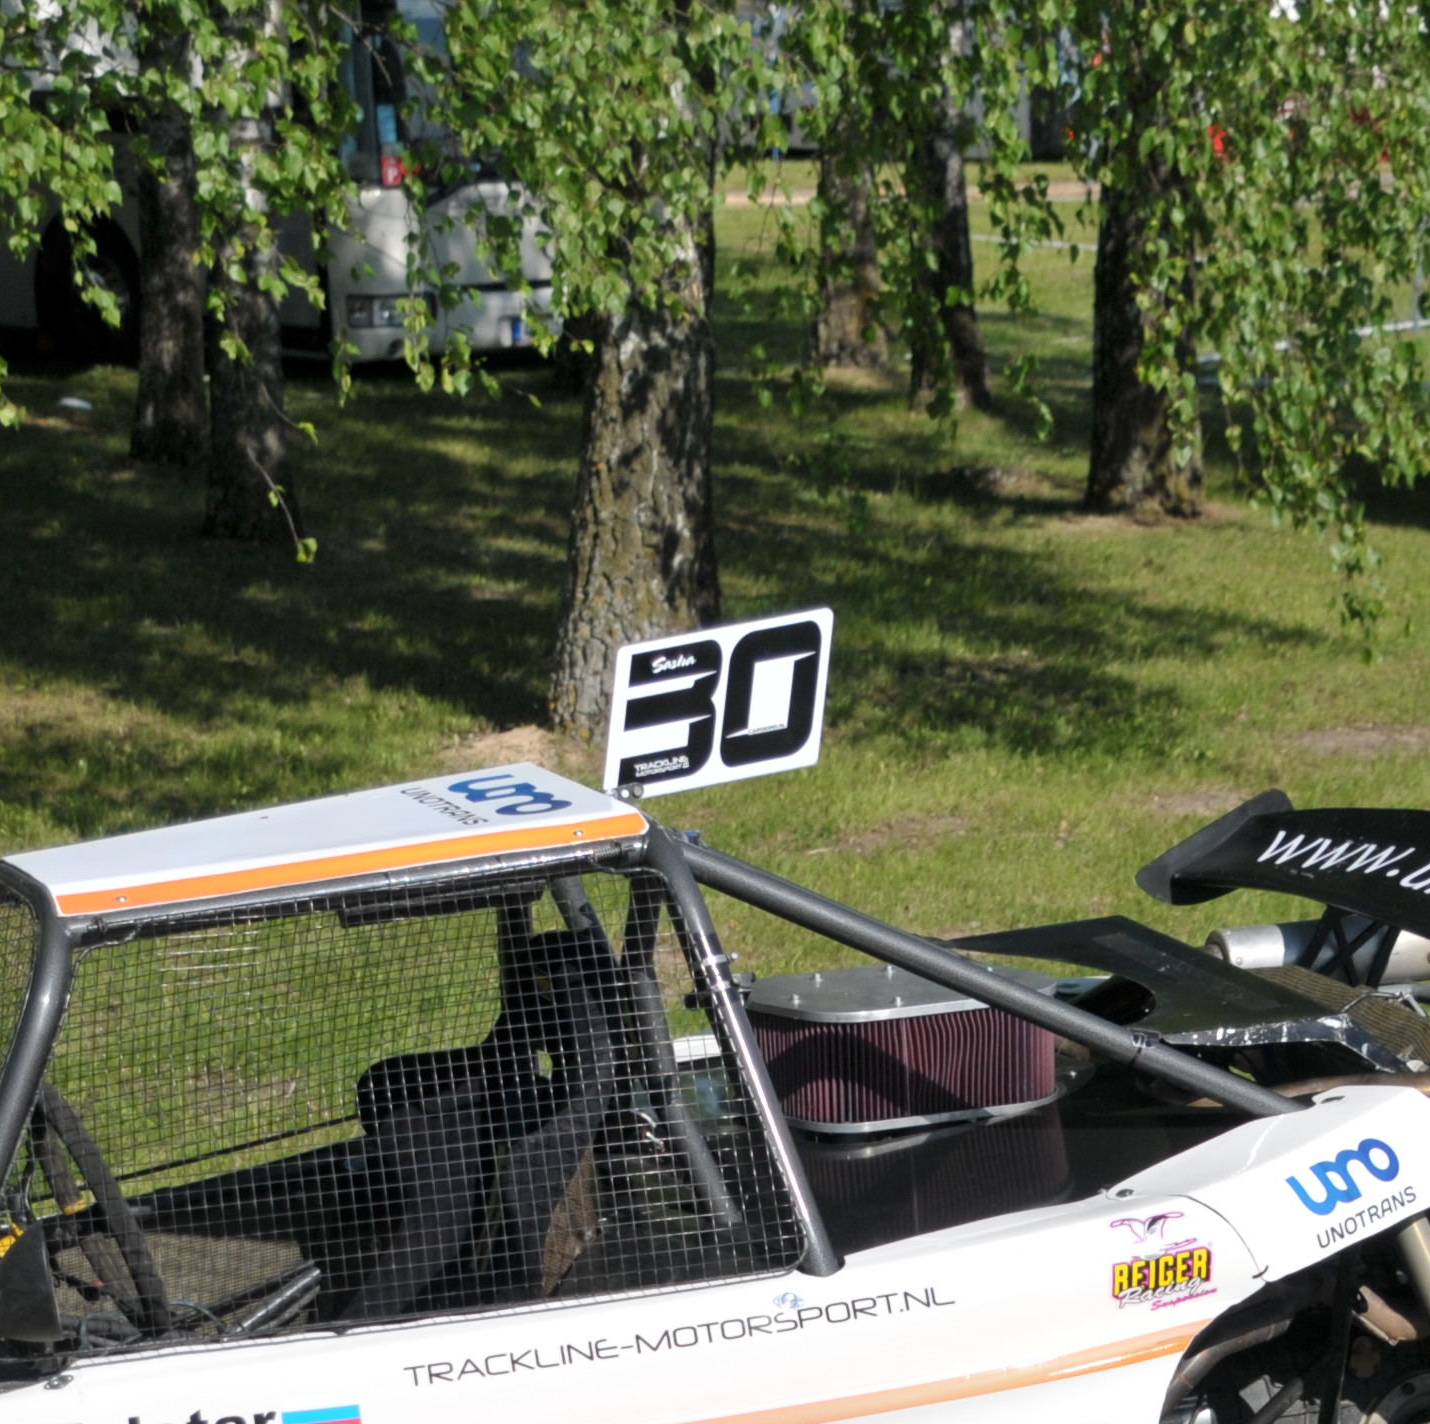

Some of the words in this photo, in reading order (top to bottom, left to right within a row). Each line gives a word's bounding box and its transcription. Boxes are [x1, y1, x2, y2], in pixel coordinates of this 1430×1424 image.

[651, 654, 697, 674] Sasha
[617, 620, 822, 787] 30
[400, 787, 489, 826] UNOTRANS
[1316, 1185, 1417, 1249] UNOTRANS
[1112, 1246, 1212, 1300] REIGER
[1118, 1276, 1203, 1309] Racing
[403, 1287, 956, 1387] TRACKLINE-MOTORSPORT.NL
